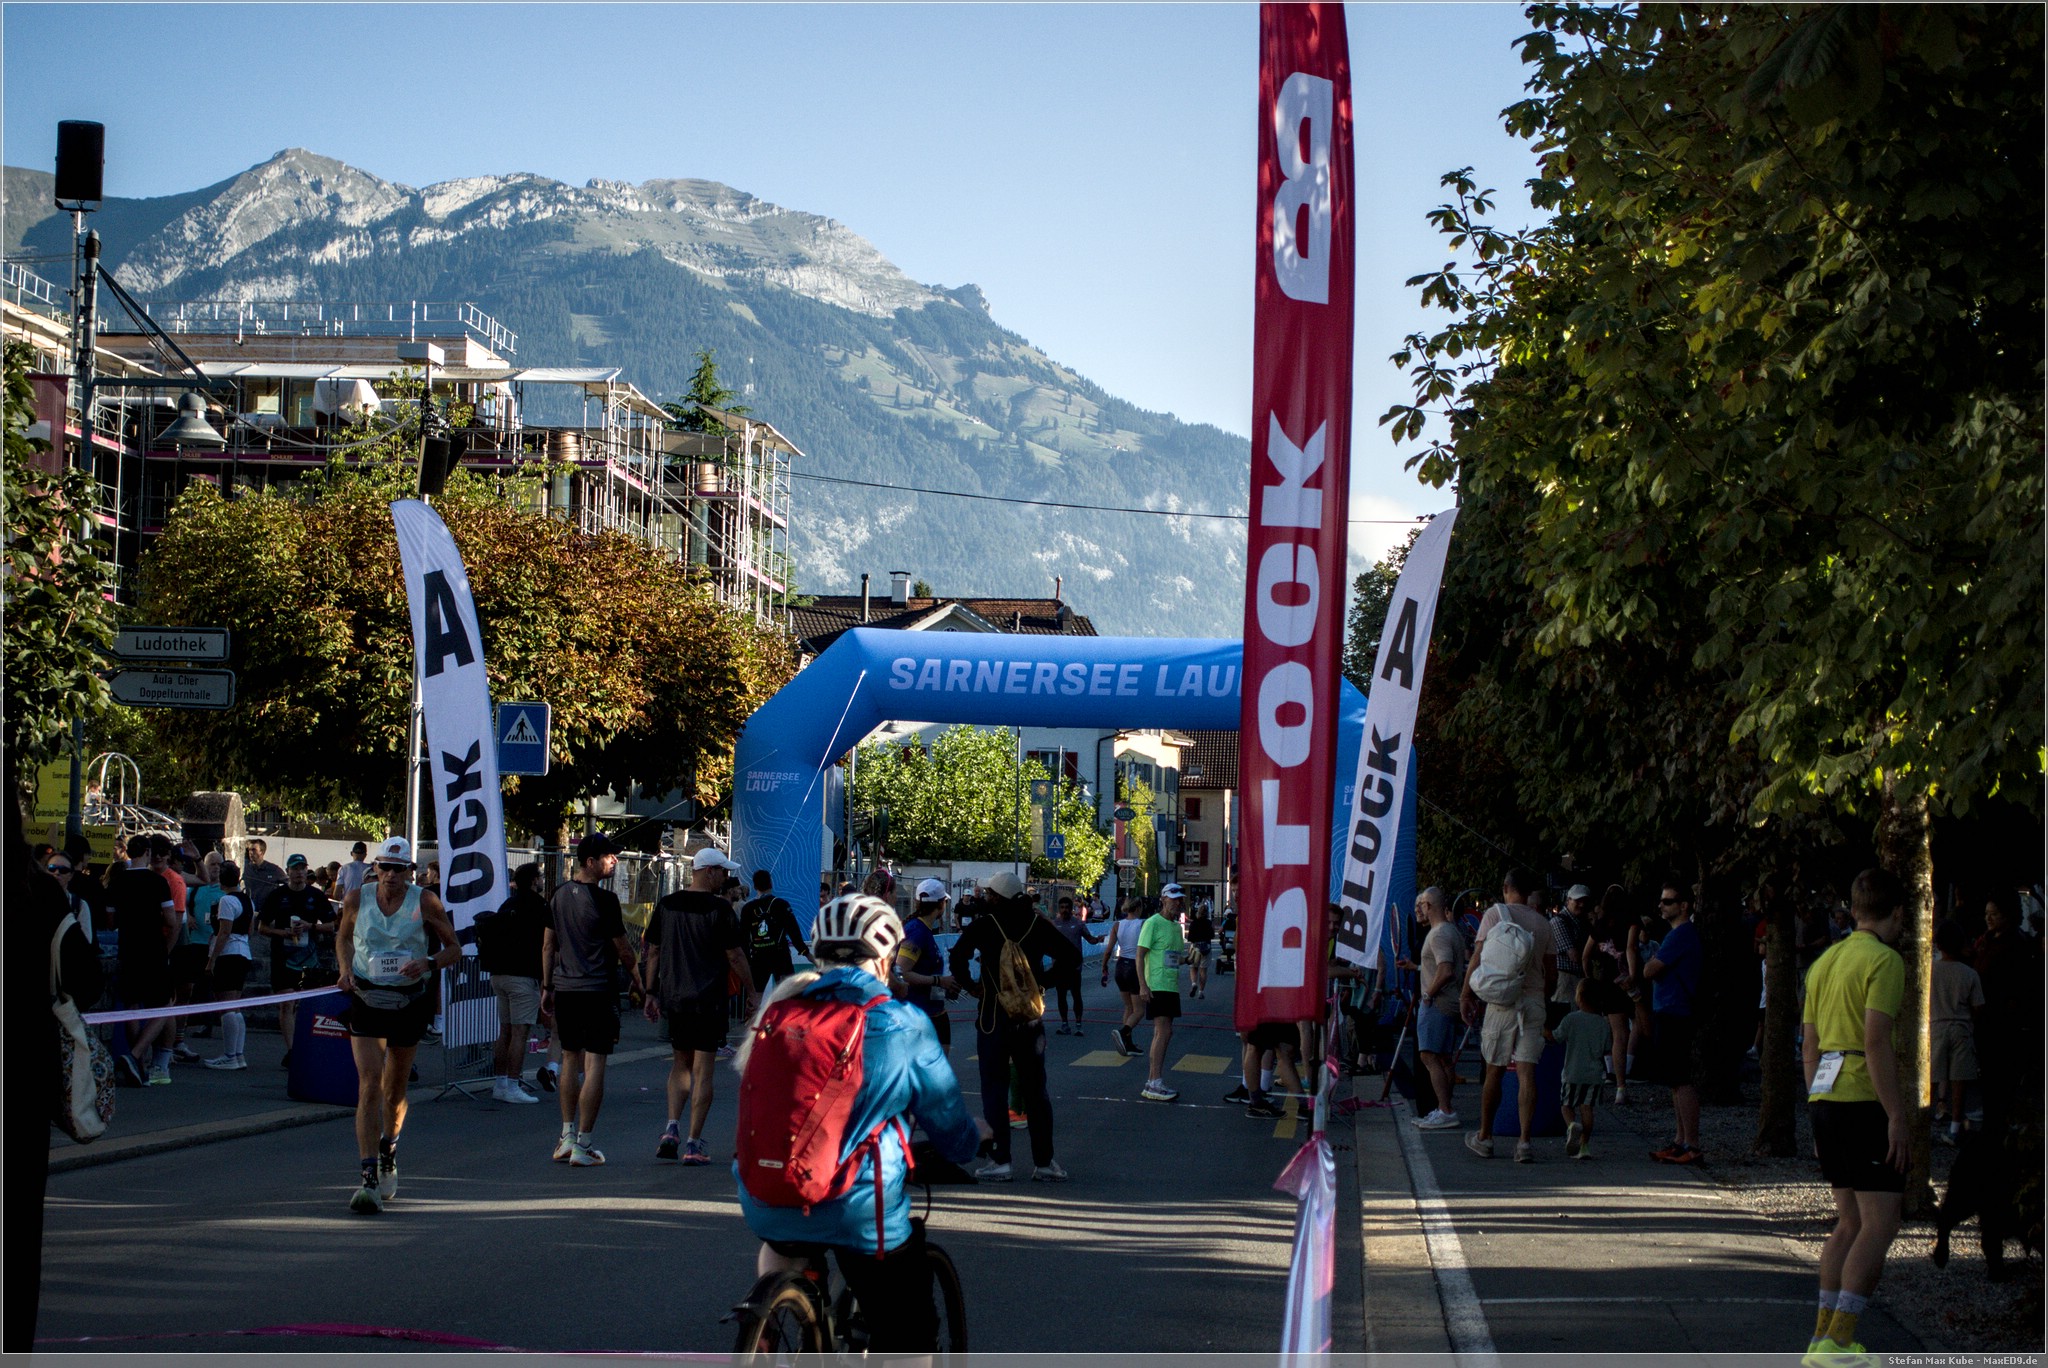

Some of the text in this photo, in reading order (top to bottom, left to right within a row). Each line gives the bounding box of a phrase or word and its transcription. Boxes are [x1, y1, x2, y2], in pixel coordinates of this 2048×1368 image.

[135, 636, 207, 652] Ludothek
[153, 674, 199, 686] Aula Cher
[889, 657, 1243, 698] SARNERSEE LAU
[140, 687, 211, 700] Doppelturnhalle
[747, 771, 800, 781] SARNERSEE
[1338, 597, 1418, 953] BLOCK A
[746, 780, 780, 792] LAUF
[85, 830, 113, 840] Damen
